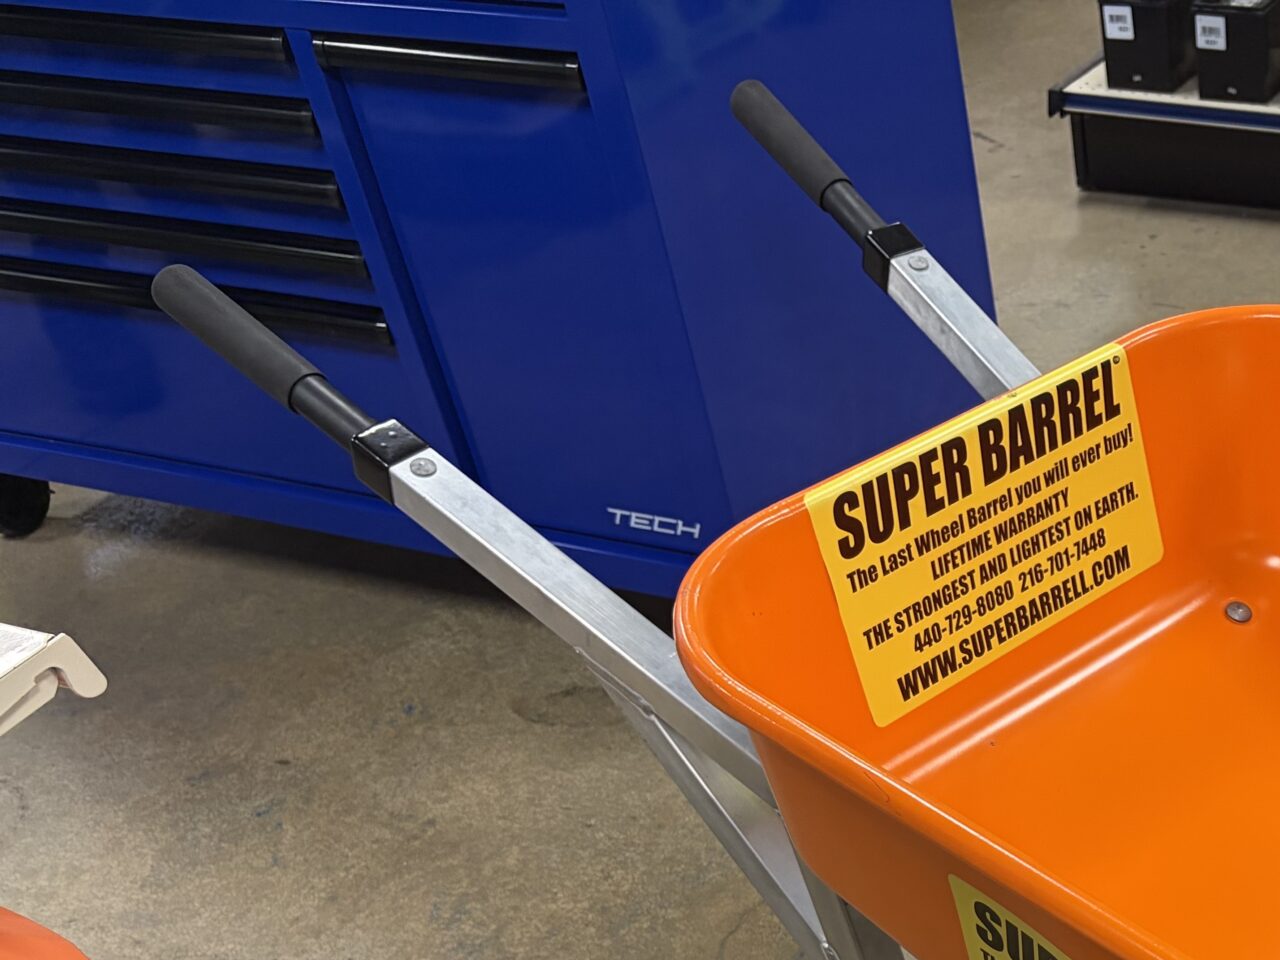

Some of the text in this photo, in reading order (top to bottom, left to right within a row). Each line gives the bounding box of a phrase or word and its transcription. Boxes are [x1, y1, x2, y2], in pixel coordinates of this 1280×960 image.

[606, 507, 701, 539] TECH
[833, 359, 1121, 560] SUPER BARREL
[846, 423, 1134, 593] The Last Wheel Barrel you will ever buy!
[930, 487, 1070, 581] LIFETIME WARRANTY
[863, 481, 1139, 651] THE STRONGEST AND LIGHTEST ON EARTH.
[896, 544, 1131, 703] WWW.SUPERBARRELL.COM
[912, 527, 1107, 654] 440-729-8080 216-701-7448
